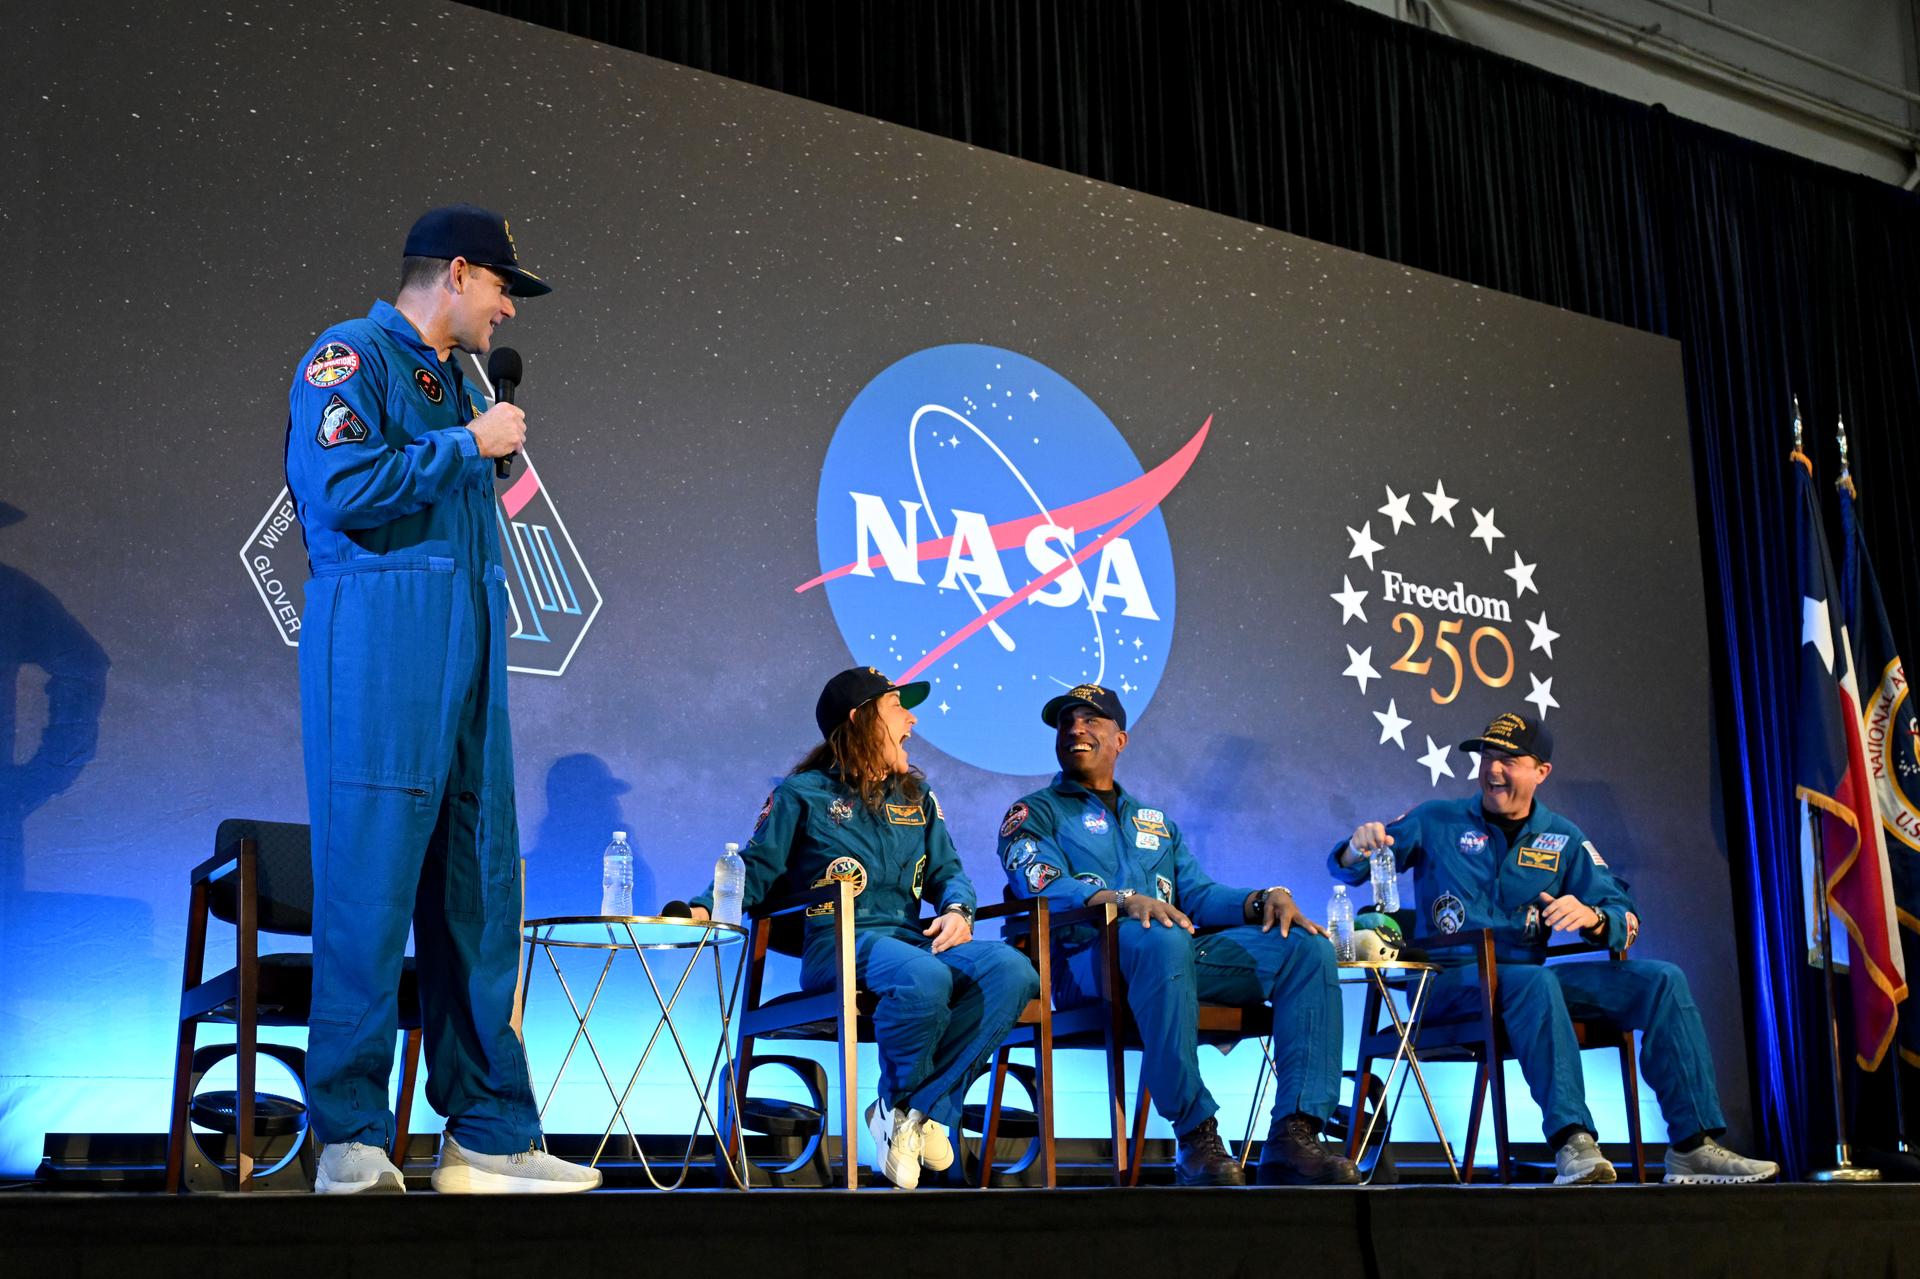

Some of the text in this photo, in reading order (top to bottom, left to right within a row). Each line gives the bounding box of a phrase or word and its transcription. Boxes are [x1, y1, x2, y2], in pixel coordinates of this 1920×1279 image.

[254, 555, 301, 634] GLOVER
[849, 491, 1160, 621] NASA
[1381, 570, 1512, 623] Freedom
[1390, 612, 1515, 705] 250
[1460, 836, 1485, 848] NASA
